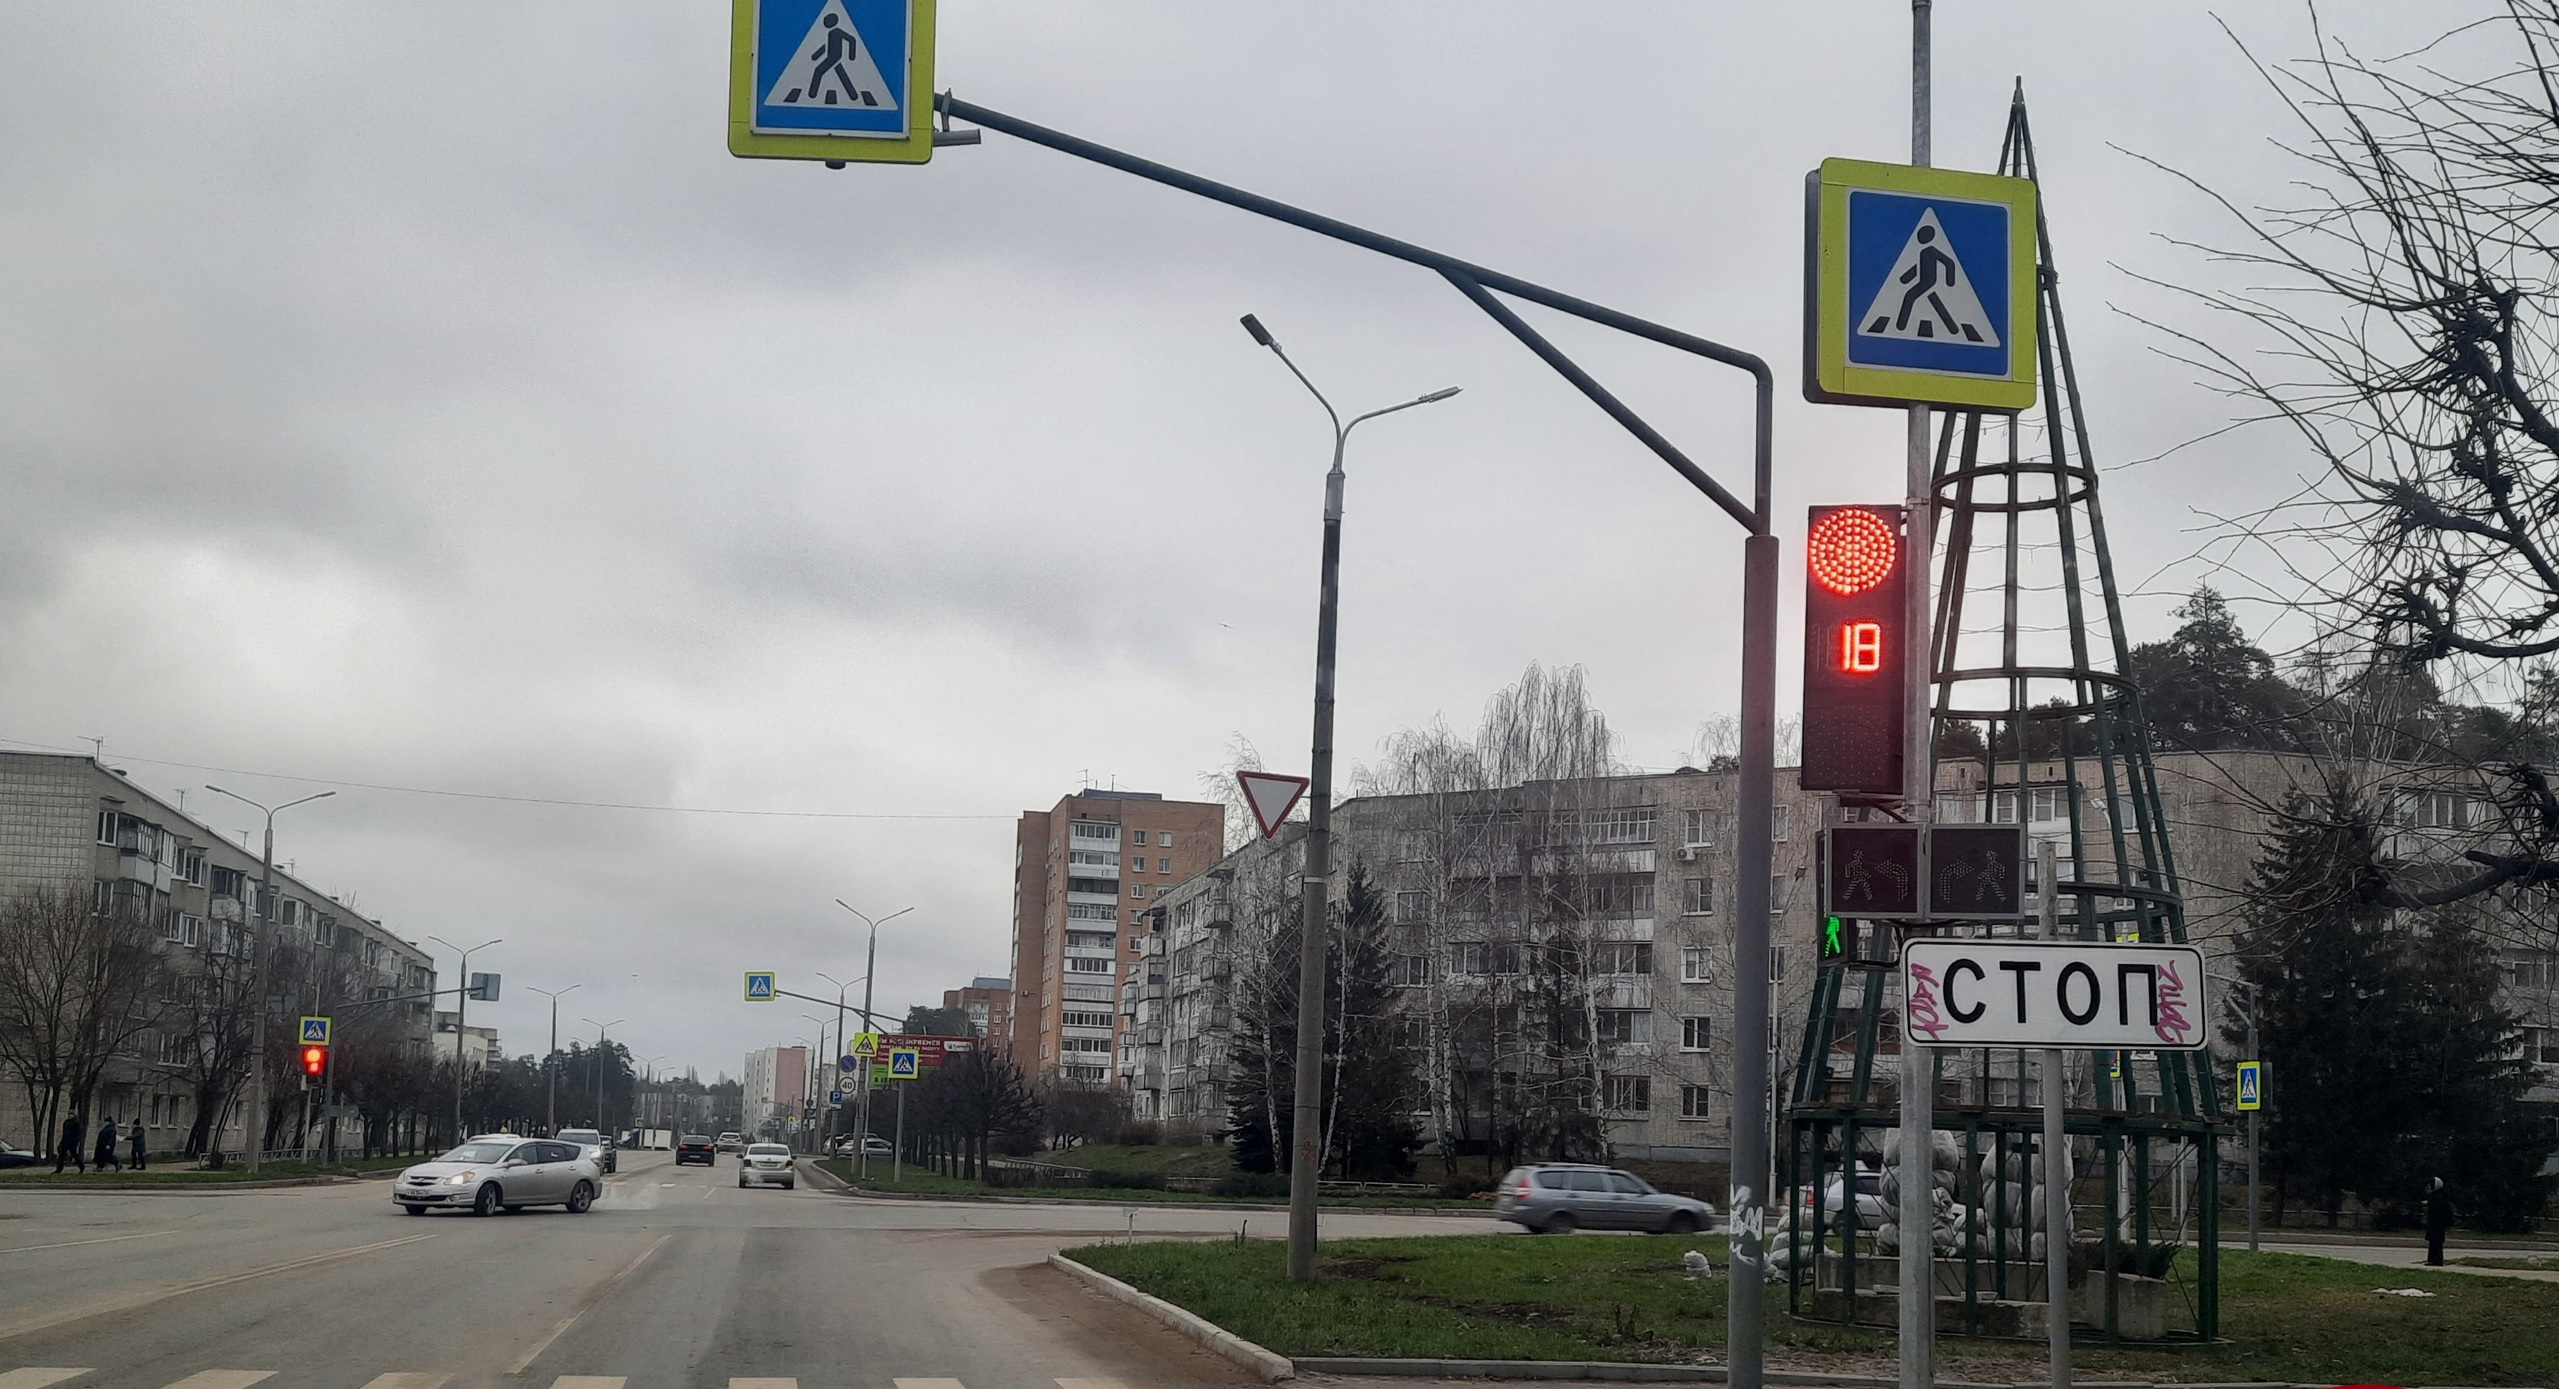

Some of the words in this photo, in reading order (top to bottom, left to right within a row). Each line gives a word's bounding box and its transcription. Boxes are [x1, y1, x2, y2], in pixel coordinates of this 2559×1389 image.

[1842, 623, 1881, 671] 18
[1942, 958, 2159, 1025] СТОП
[832, 1092, 840, 1102] P
[842, 1081, 852, 1089] 40
